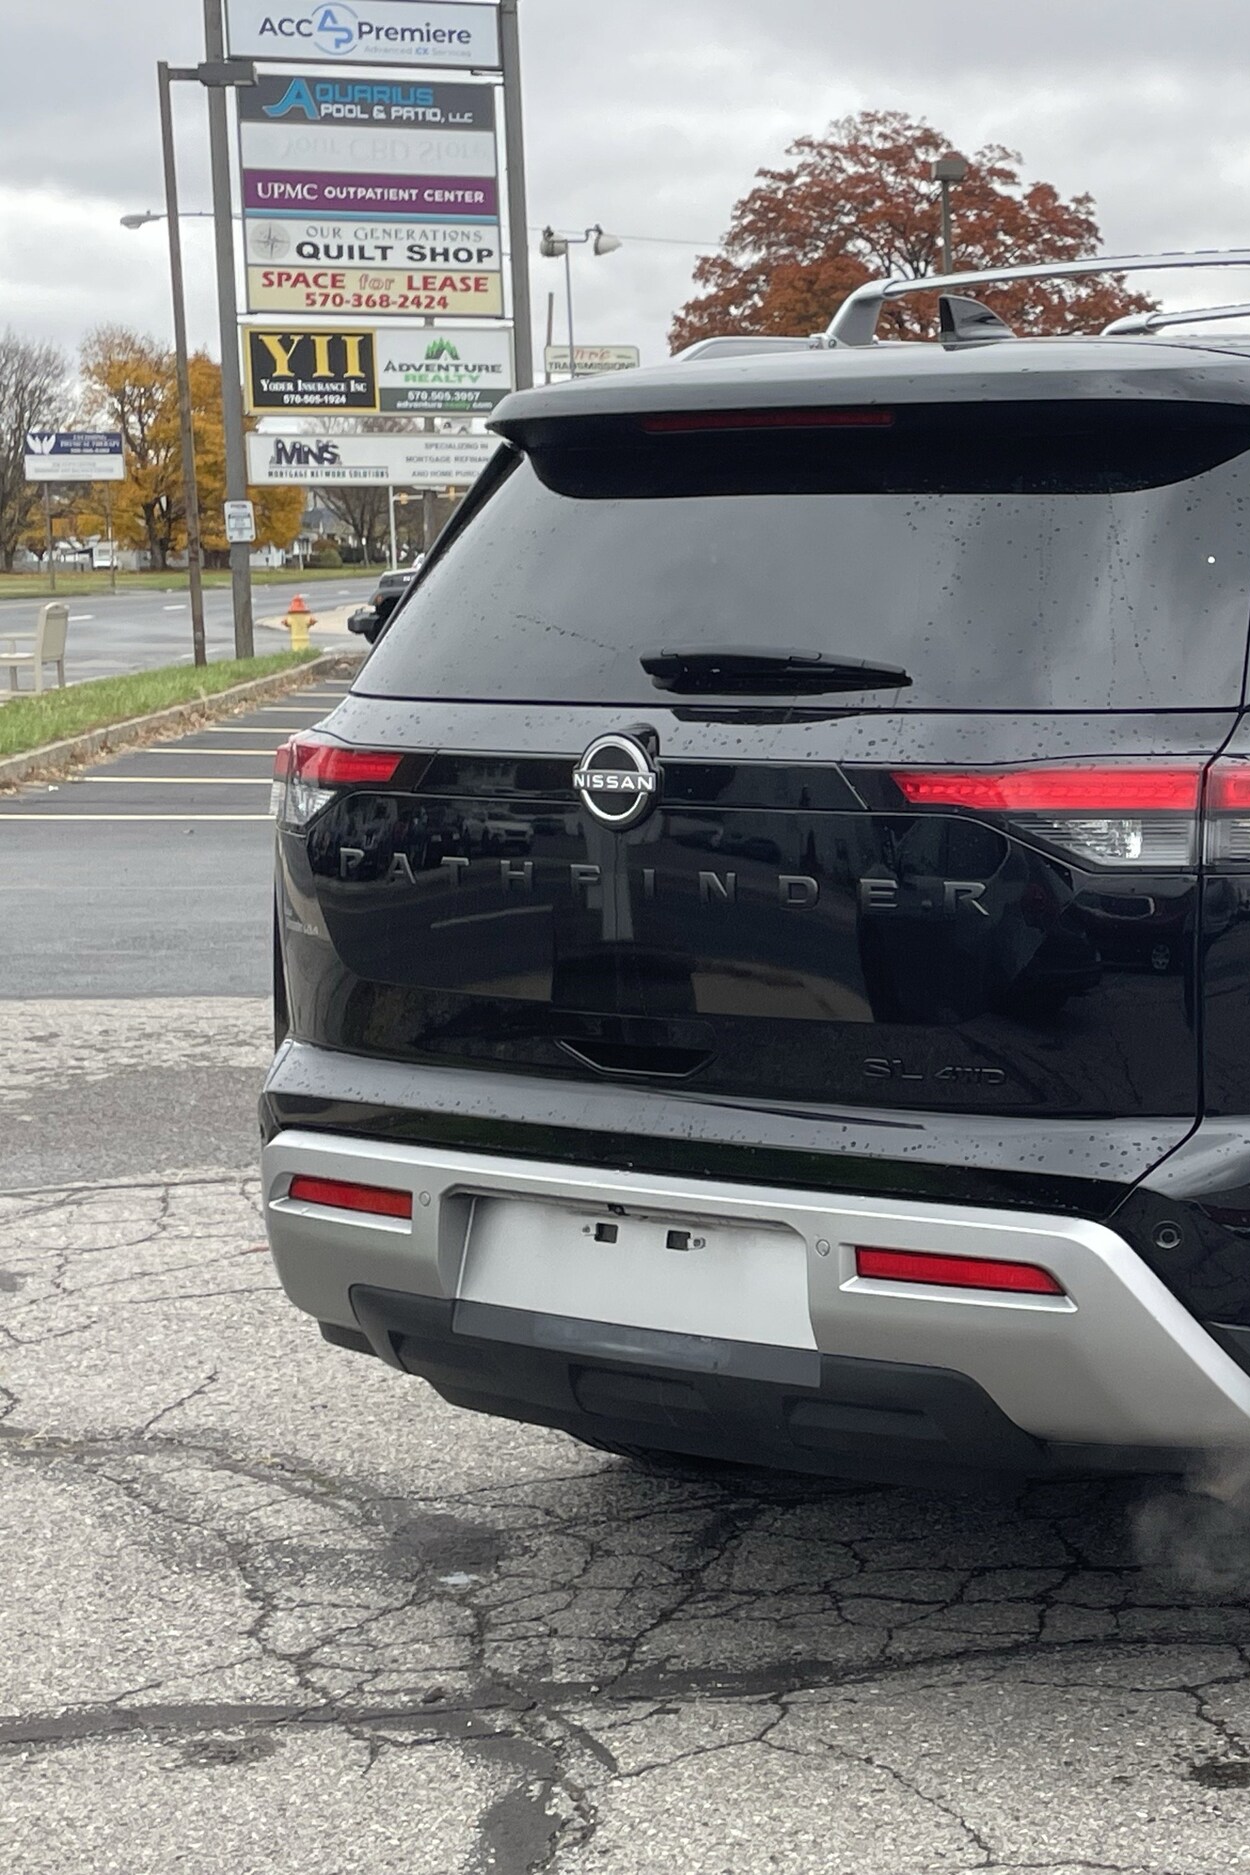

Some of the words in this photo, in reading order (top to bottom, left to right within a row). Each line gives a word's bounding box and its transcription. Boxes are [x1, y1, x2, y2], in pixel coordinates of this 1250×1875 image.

[258, 17, 314, 37] ACC
[357, 21, 472, 45] Premiere
[262, 77, 434, 120] AQUARIUS
[320, 103, 369, 120] POOL
[372, 105, 387, 120] &
[391, 106, 446, 123] PATIO,
[448, 111, 474, 123] LLC
[256, 181, 318, 201] UPMC
[324, 185, 419, 202] OUTPATIENT
[423, 189, 485, 204] CENTER
[305, 225, 342, 239] OUR
[353, 226, 483, 243] GENERATIONS
[295, 241, 394, 261] QUILT
[406, 244, 494, 264] SHOP
[261, 271, 346, 290] SPACE
[358, 273, 395, 292] for
[406, 274, 489, 293] LEASE
[304, 292, 449, 311] 570-368-2424
[258, 334, 366, 379] YII
[383, 358, 503, 374] ADVENTURE
[297, 379, 347, 393] INSURANCE
[404, 373, 481, 384] REALTY
[454, 456, 489, 464] REFINAN
[268, 470, 308, 478] MORTGAGE
[310, 470, 346, 478] NETWORK
[348, 469, 389, 478] SOLUTIONS
[455, 470, 480, 478] PURC
[574, 773, 653, 791] NISSAN
[338, 845, 990, 917] PATHFINDER
[862, 1057, 924, 1081] SL
